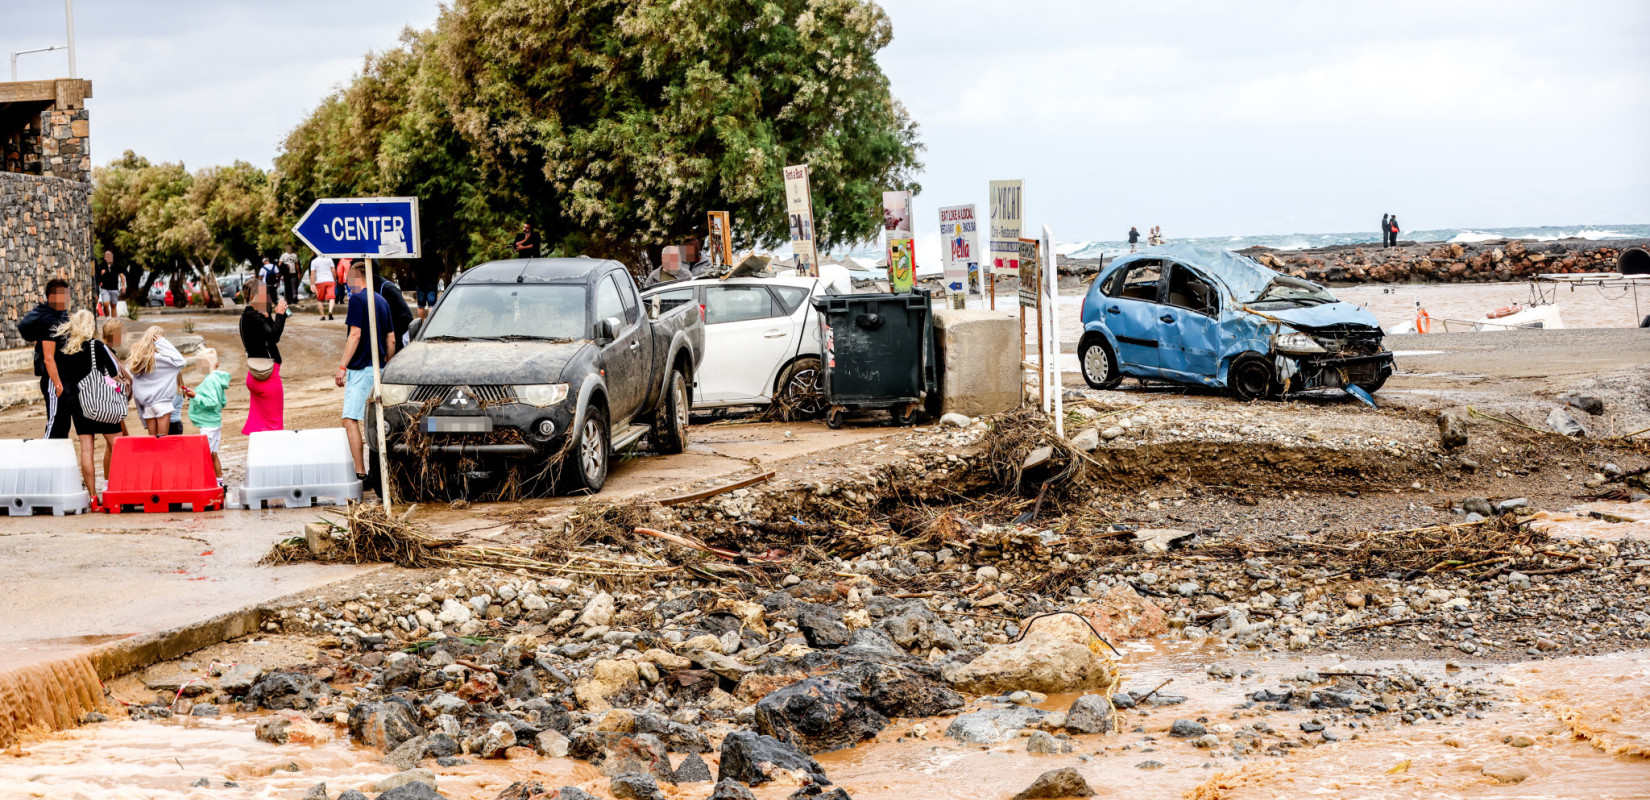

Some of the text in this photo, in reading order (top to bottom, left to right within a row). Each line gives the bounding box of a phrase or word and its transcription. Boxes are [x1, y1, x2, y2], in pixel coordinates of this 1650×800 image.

[941, 210, 949, 221] EAT
[949, 209, 958, 221] LIKE
[961, 207, 974, 220] LOCAL
[998, 186, 1021, 220] YACHT
[331, 215, 406, 241] CENTER
[951, 239, 970, 262] Pella
